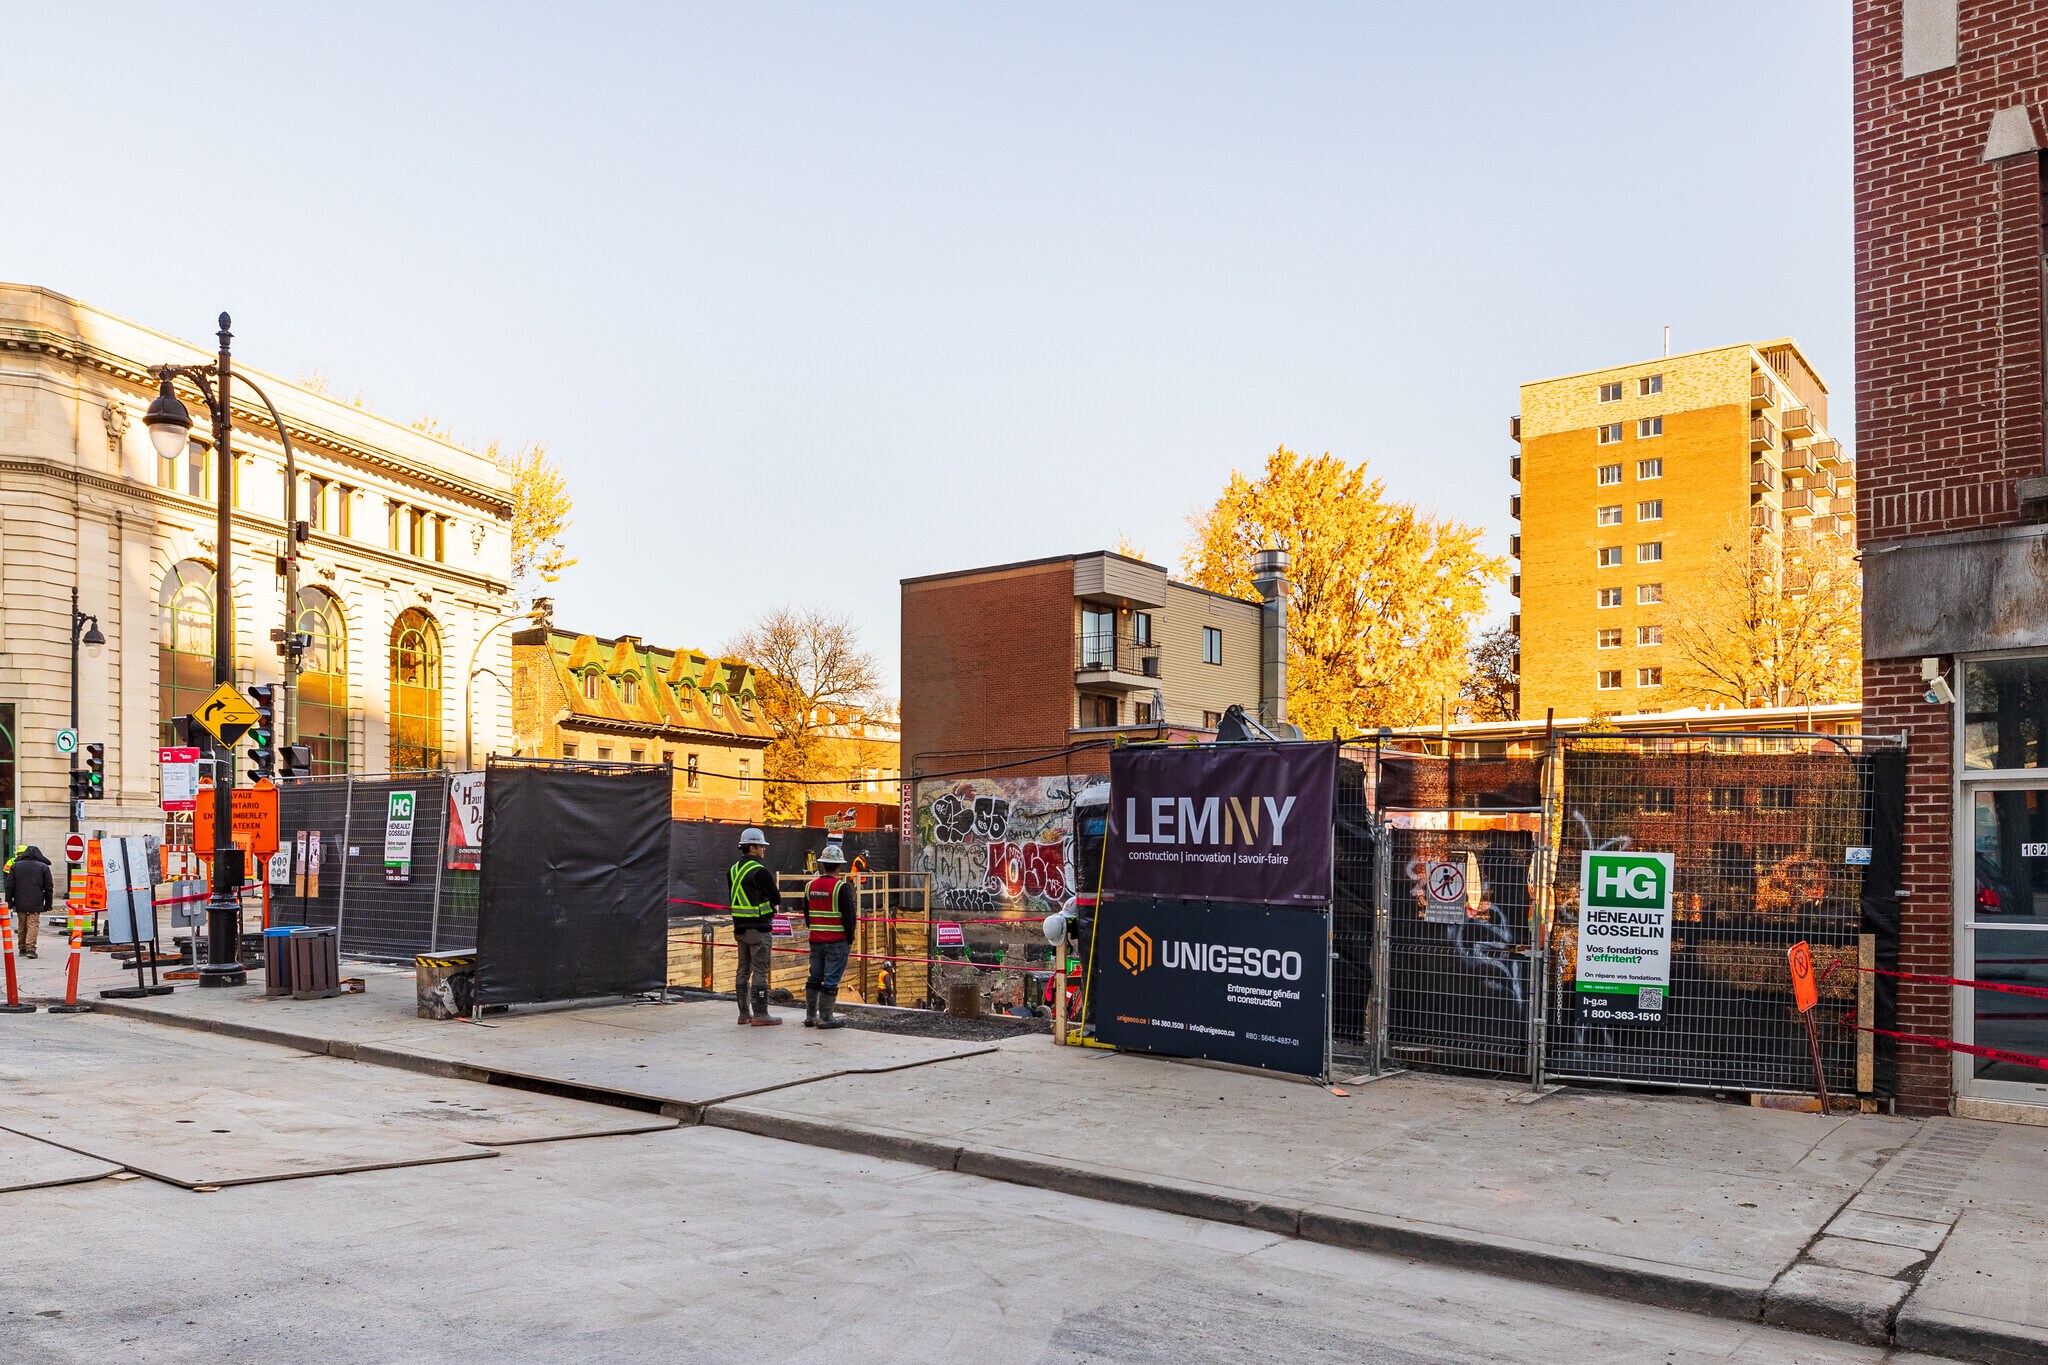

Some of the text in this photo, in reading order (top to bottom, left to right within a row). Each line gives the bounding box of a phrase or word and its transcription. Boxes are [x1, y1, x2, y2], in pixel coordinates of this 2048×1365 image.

[392, 799, 410, 816] HG
[233, 812, 268, 820] IMBERLEY
[1126, 797, 1296, 845] LEMNY
[232, 822, 260, 830] ATEKEN
[91, 859, 104, 868] BARR
[1128, 850, 1289, 865] construction innovation savoir-faire
[1596, 866, 1656, 900] HG
[1586, 924, 1664, 938] GOSSELIN
[1586, 944, 1659, 956] Vos fondations
[1162, 940, 1302, 981] UNIGESCO
[1586, 954, 1642, 964] s'effritent?
[1227, 984, 1300, 1000] Entrepreneur général
[1238, 996, 1282, 1008] construction
[1583, 996, 1608, 1007] h-g.ca
[1583, 1009, 1661, 1022] 1 800-363-1510
[1190, 1024, 1235, 1037] info@unigesco.ca
